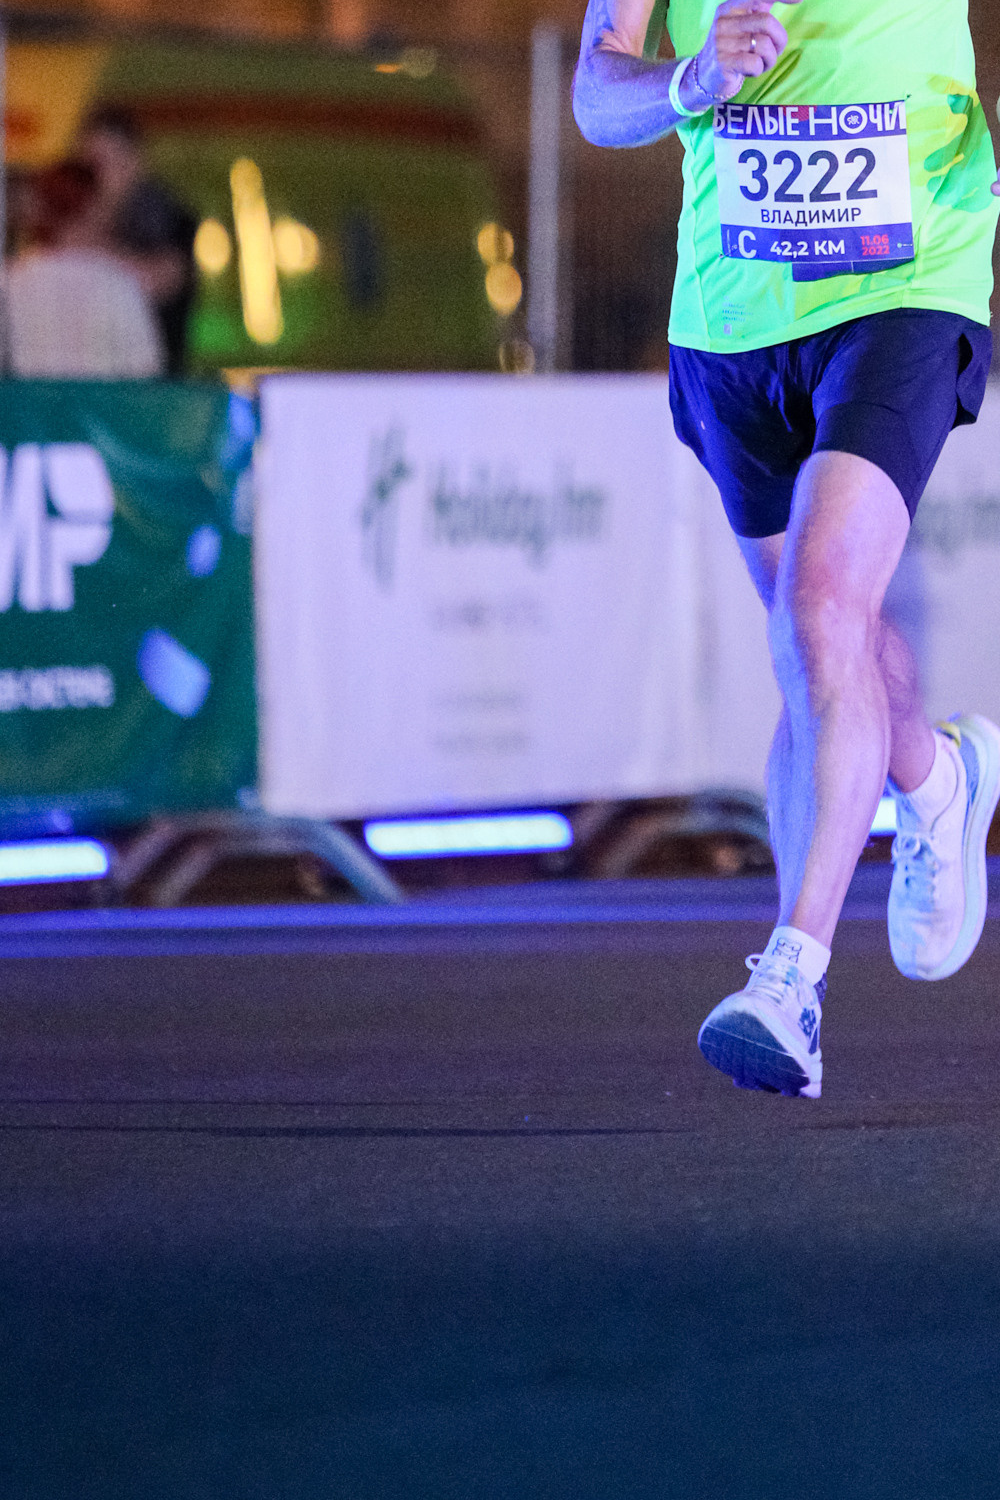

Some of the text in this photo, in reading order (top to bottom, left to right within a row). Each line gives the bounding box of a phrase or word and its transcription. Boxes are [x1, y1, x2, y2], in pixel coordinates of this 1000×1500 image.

[714, 100, 907, 135] БЕЛЫЕ НОЧИ
[737, 147, 878, 203] 3222
[760, 208, 861, 227] ВЛАДИМИР
[770, 240, 809, 258] 42,2
[814, 239, 845, 255] КМ
[860, 234, 889, 246] 11.06
[862, 245, 890, 256] 2022
